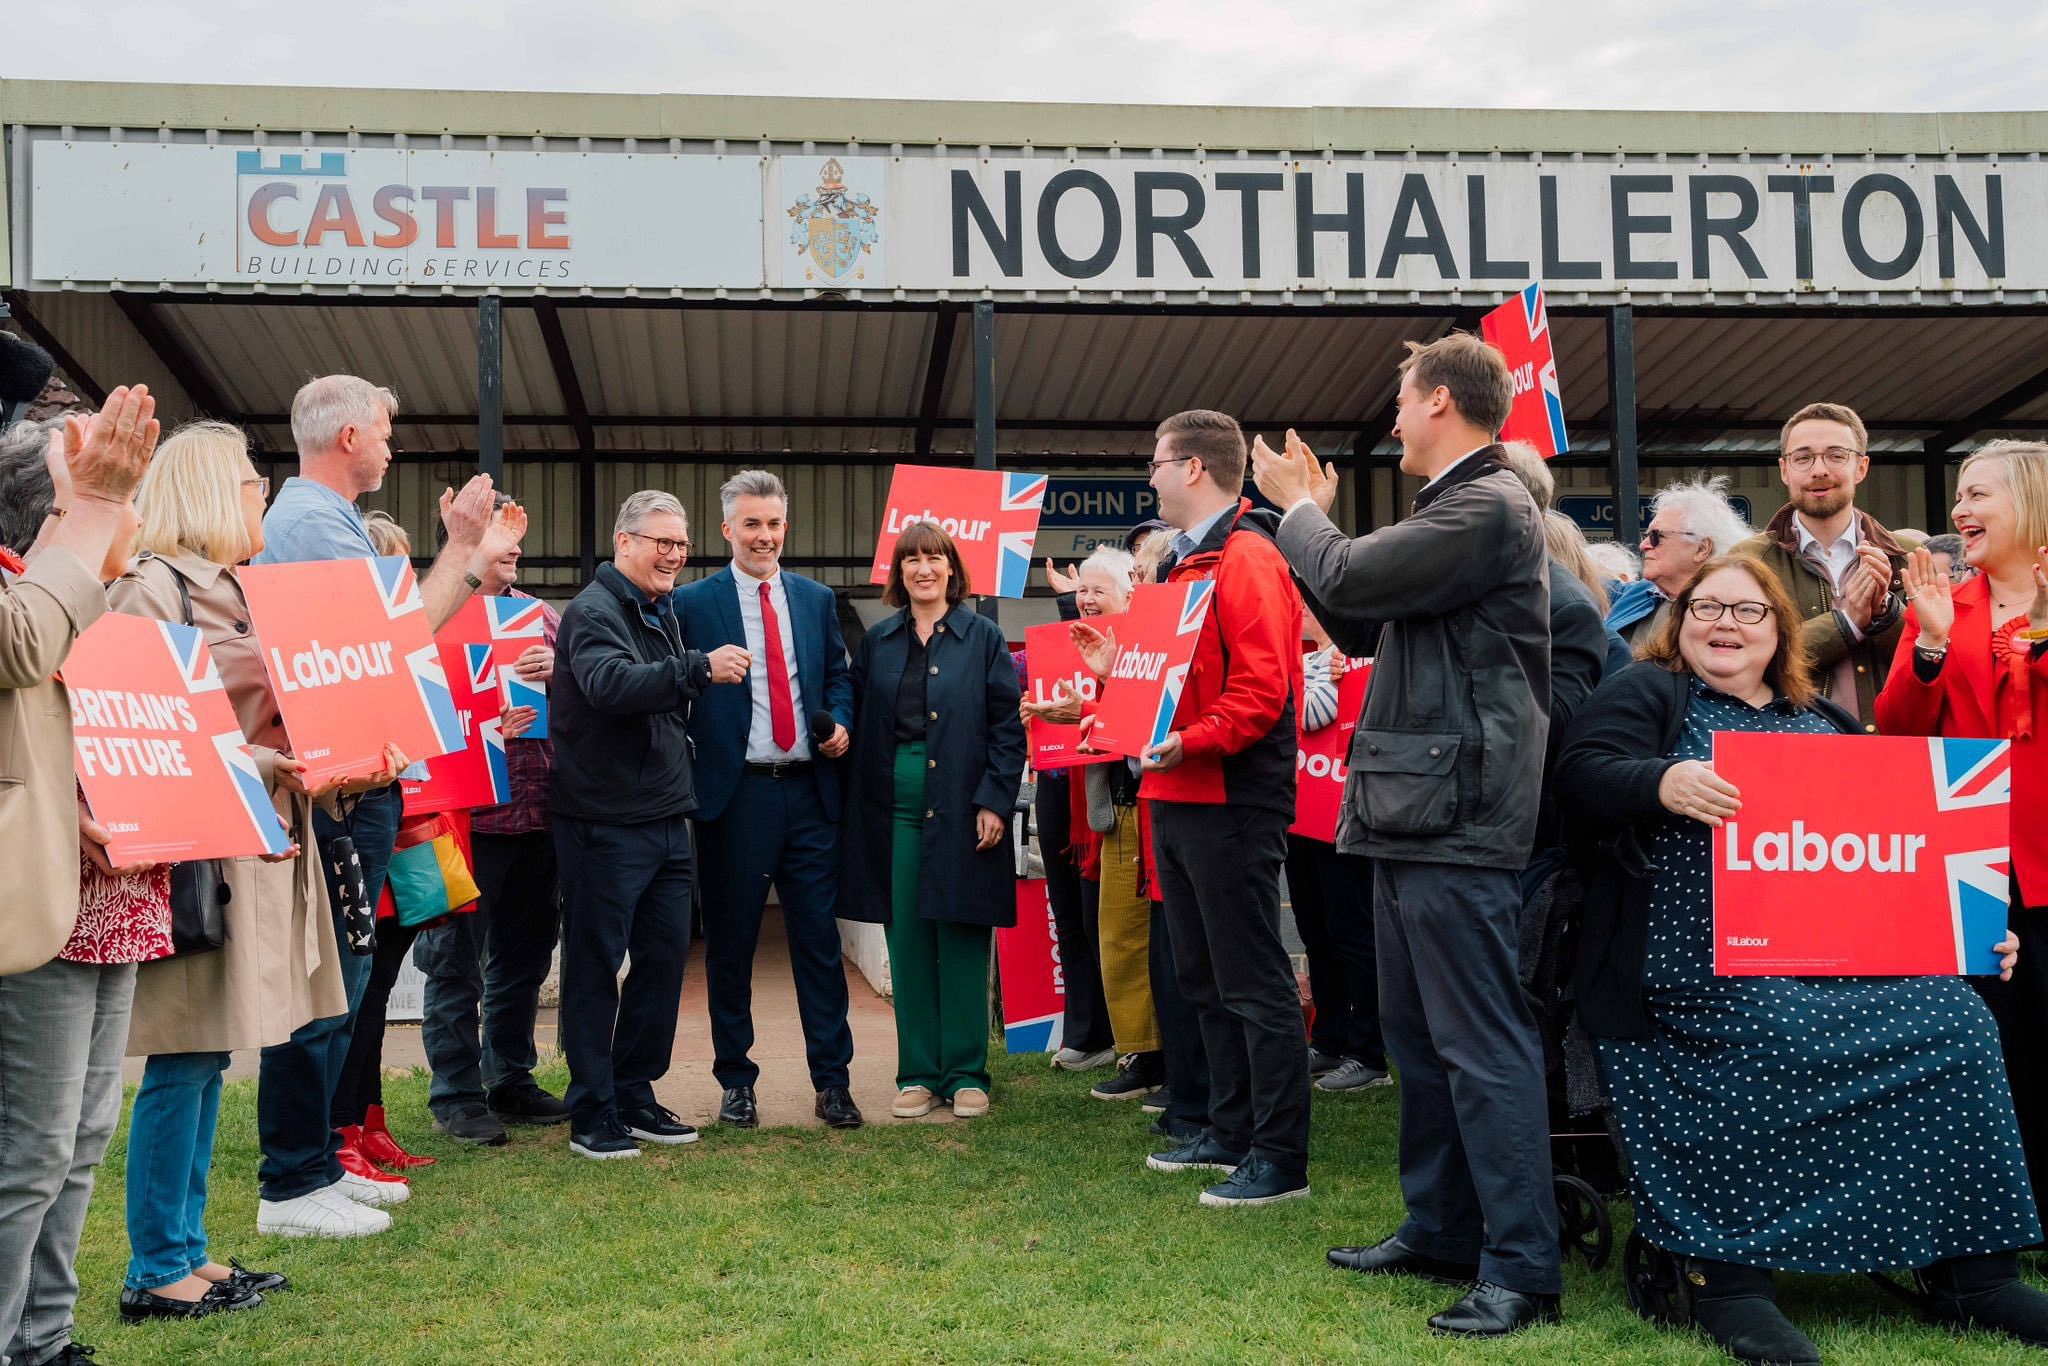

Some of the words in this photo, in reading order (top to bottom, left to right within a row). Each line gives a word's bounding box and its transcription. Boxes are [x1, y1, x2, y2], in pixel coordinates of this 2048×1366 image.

[247, 182, 571, 249] CASTLE
[951, 168, 2006, 279] NORTHALLERTON
[247, 256, 403, 277] BUILDING
[424, 258, 571, 278] SERVICES
[1043, 490, 1125, 516] JOHN
[271, 639, 395, 693] Labour
[1111, 642, 1168, 681] Labour
[1035, 671, 1097, 705] Lab
[74, 736, 193, 777] FUTURE
[1726, 820, 1926, 873] Labour
[1735, 936, 1769, 947] Labour
